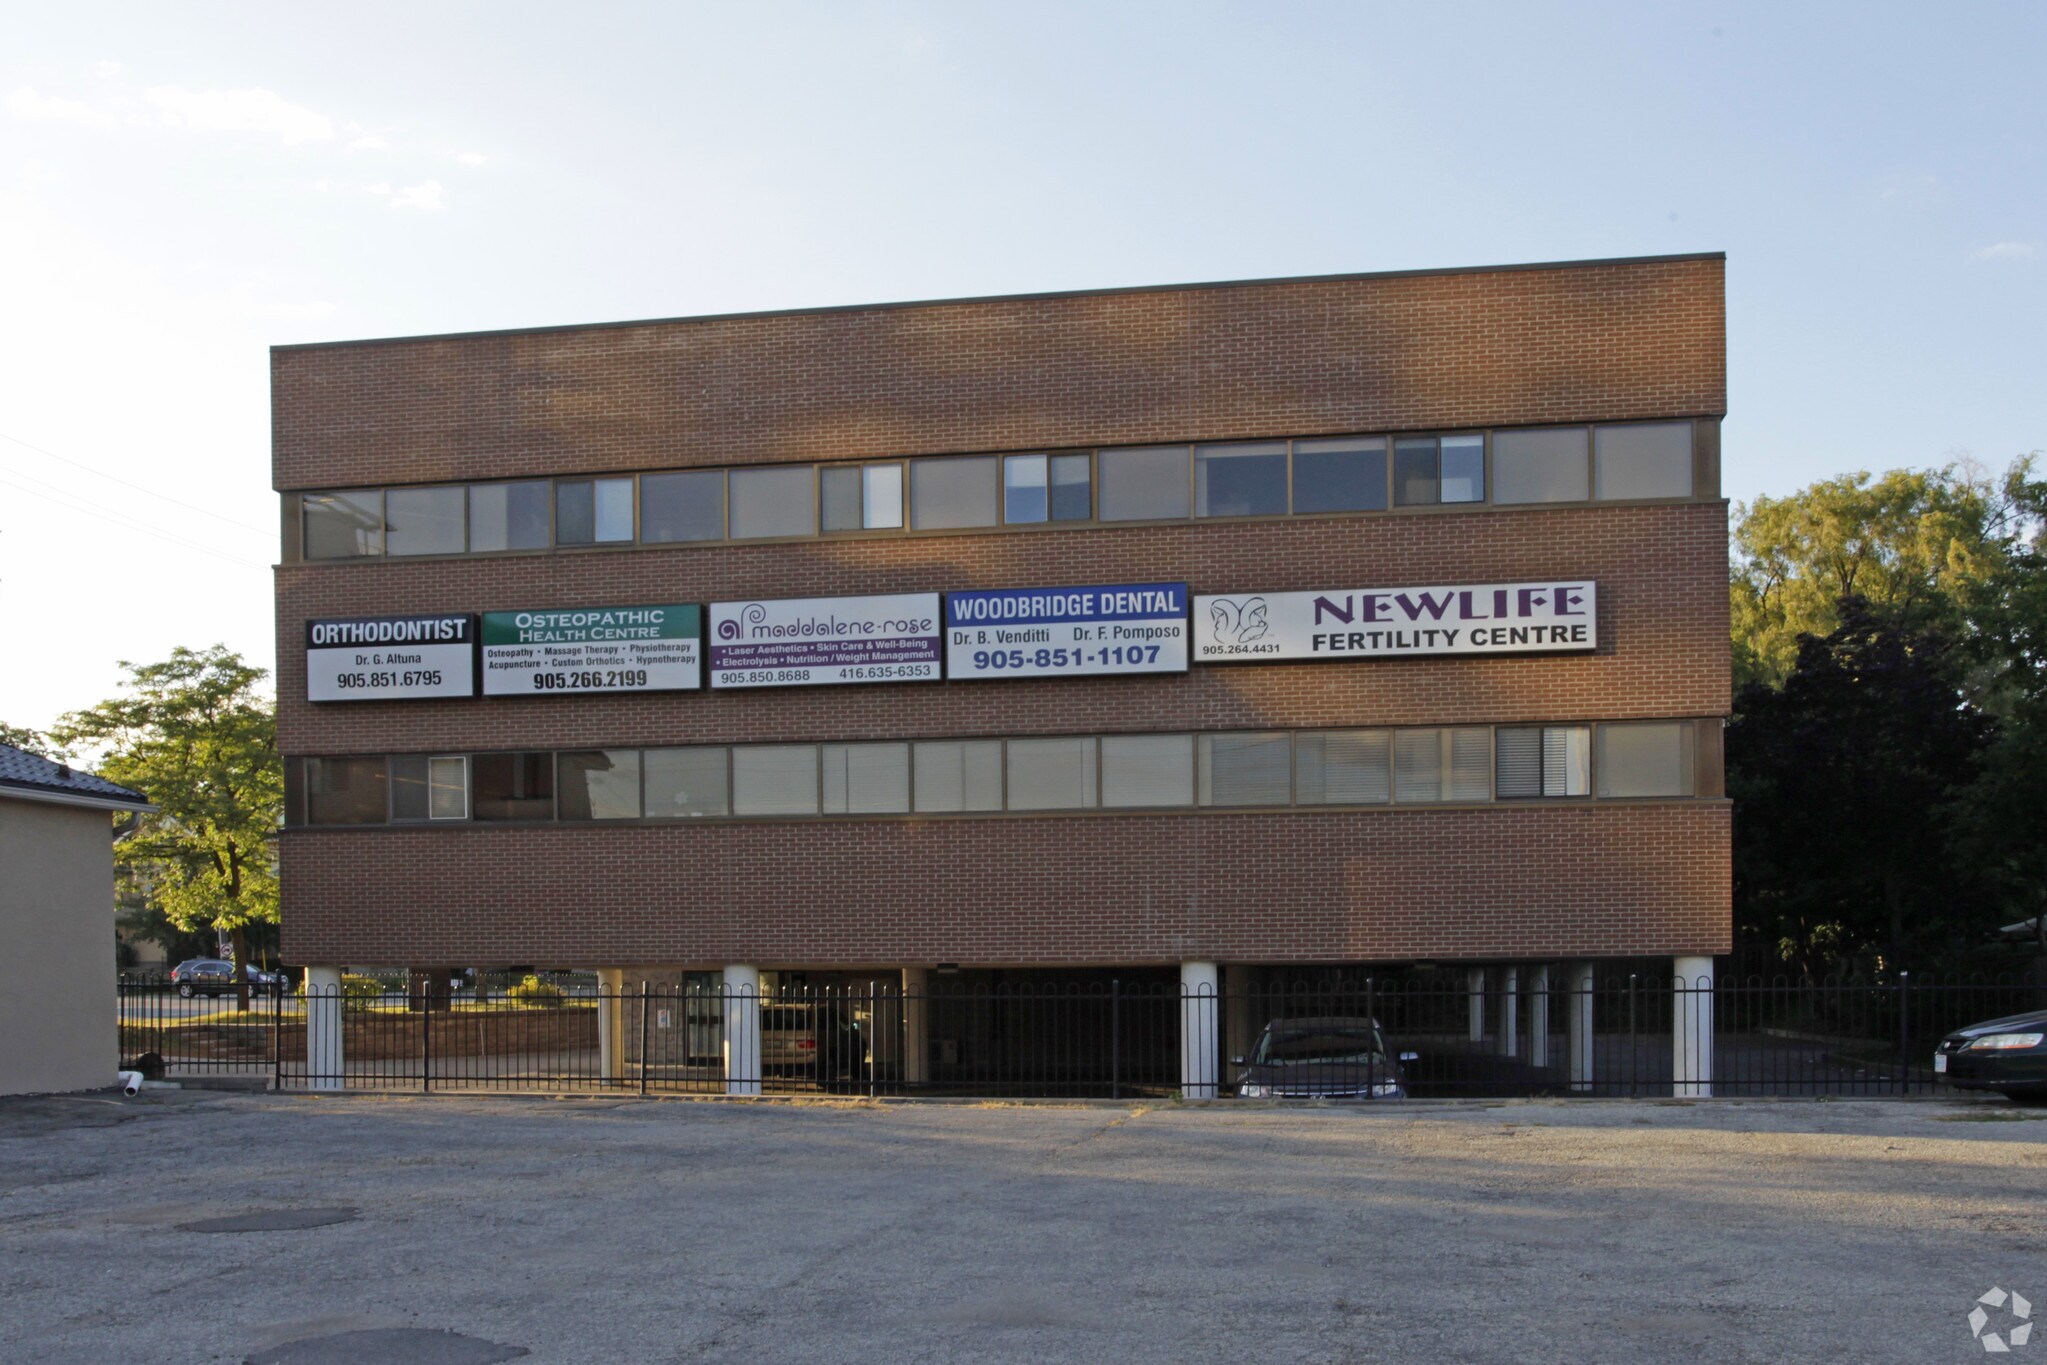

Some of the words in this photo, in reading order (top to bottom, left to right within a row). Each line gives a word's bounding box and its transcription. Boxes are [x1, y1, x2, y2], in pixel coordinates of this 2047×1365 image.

[954, 594, 1094, 620] WOODBRIDGE
[1101, 590, 1180, 615] DENTAL
[1313, 586, 1587, 626] NEWLIFE
[515, 610, 664, 629] OSTEOPATHIC
[752, 614, 933, 639] maddalene-rose
[312, 618, 467, 645] ORTHODONTIST
[519, 629, 586, 643] HEALTH
[590, 627, 660, 641] CENTRE
[953, 631, 972, 645] Dr.
[977, 630, 991, 644] B.
[996, 628, 1050, 644] Venditti
[1073, 627, 1093, 641] Dr.
[1098, 626, 1108, 640] F.
[1113, 625, 1181, 642] Pomposo
[1312, 628, 1460, 651] FERTILITY
[1470, 624, 1587, 646] CENTRE
[487, 648, 534, 659] Osteopathy
[544, 646, 582, 657] Massage
[584, 645, 619, 656] Therapy
[629, 643, 691, 654] Physiotherapy
[728, 646, 757, 656] Laser
[757, 644, 809, 655] Aesthetics
[816, 642, 838, 652] Skin
[841, 641, 864, 651] Care
[866, 640, 874, 650] &
[875, 639, 929, 651] Well-Being
[1202, 643, 1280, 656] 905.264.4431
[355, 655, 370, 666] Dr.
[373, 654, 384, 665] G.
[386, 653, 422, 665] Altuna
[488, 660, 541, 671] Acupuncture
[551, 658, 583, 668] Custom
[586, 656, 626, 667] Orthotics
[636, 655, 696, 666] Hypnotherapy
[722, 656, 778, 668] Electrolysis
[786, 654, 829, 665] Nutrition
[836, 651, 870, 664] Weight
[872, 649, 935, 662] Management
[973, 645, 1161, 670] 905-851-1107
[337, 670, 442, 688] 905.851.6795
[533, 670, 648, 690] 905.266.2199
[721, 670, 811, 684] 905.850.8688
[839, 665, 932, 680] 416.635-6353
